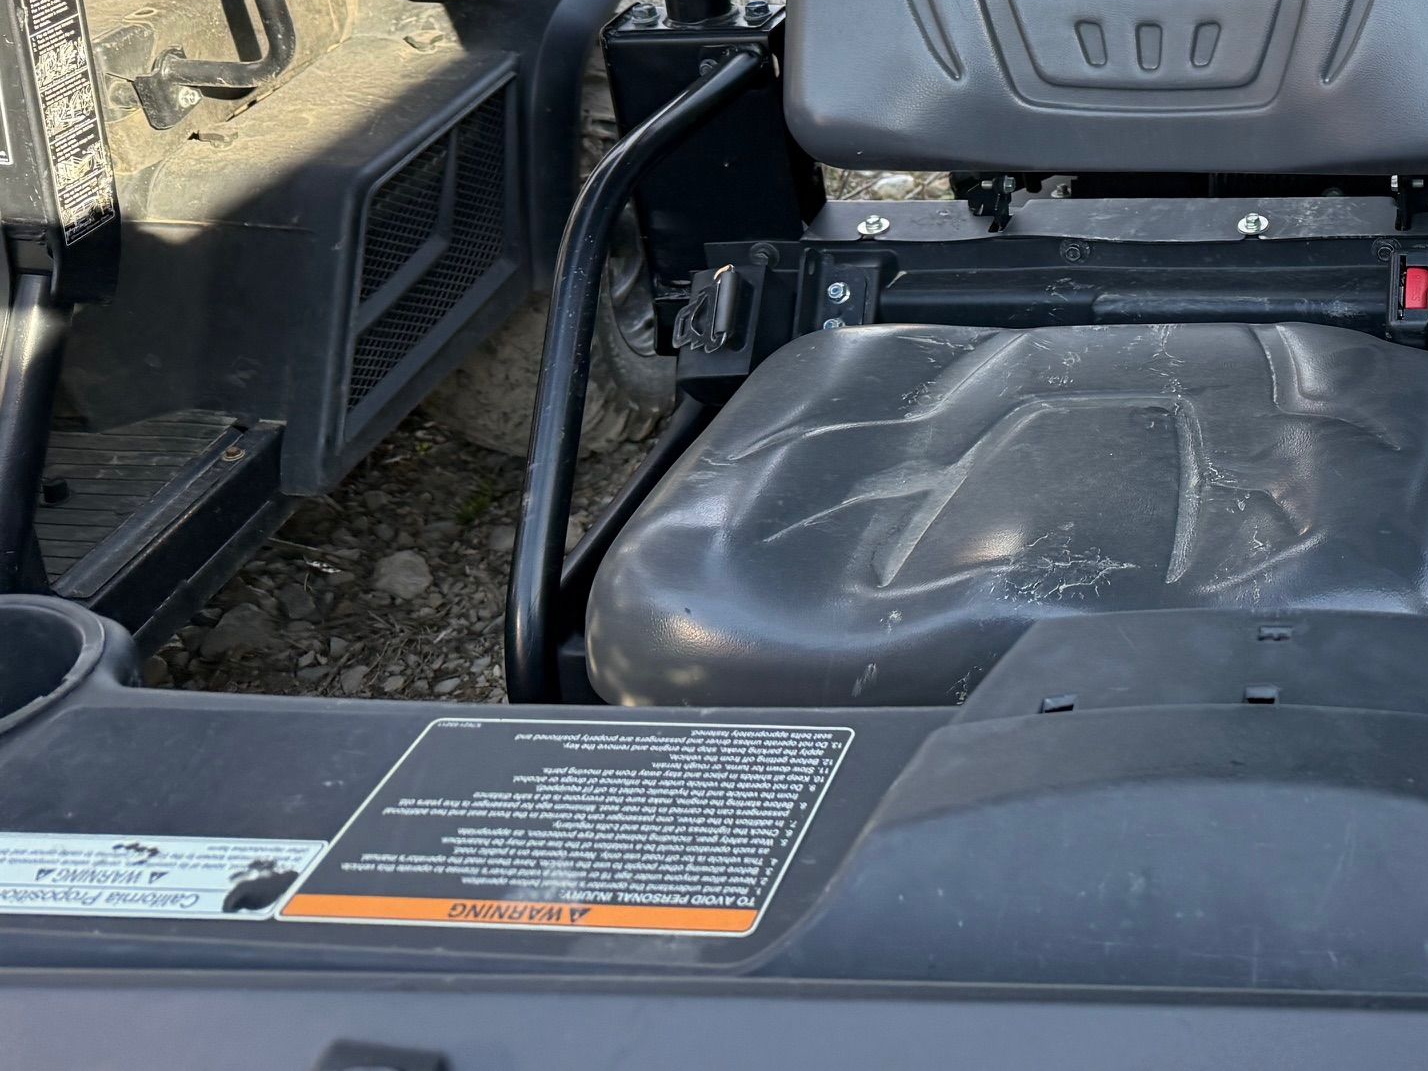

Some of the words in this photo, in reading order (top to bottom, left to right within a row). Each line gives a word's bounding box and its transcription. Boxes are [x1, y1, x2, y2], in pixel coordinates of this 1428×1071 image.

[532, 732, 581, 741] positioned
[579, 733, 619, 742] properly
[634, 735, 686, 743] passengers
[731, 738, 762, 746] unless
[762, 738, 798, 747] operate
[566, 767, 602, 776] moving
[738, 773, 772, 781] shields
[54, 868, 144, 885] WARNING
[103, 891, 200, 908] California
[614, 893, 689, 903] PERSONAL
[690, 896, 734, 905] AVOID
[736, 897, 756, 906] TO
[446, 903, 563, 921] WARNING
